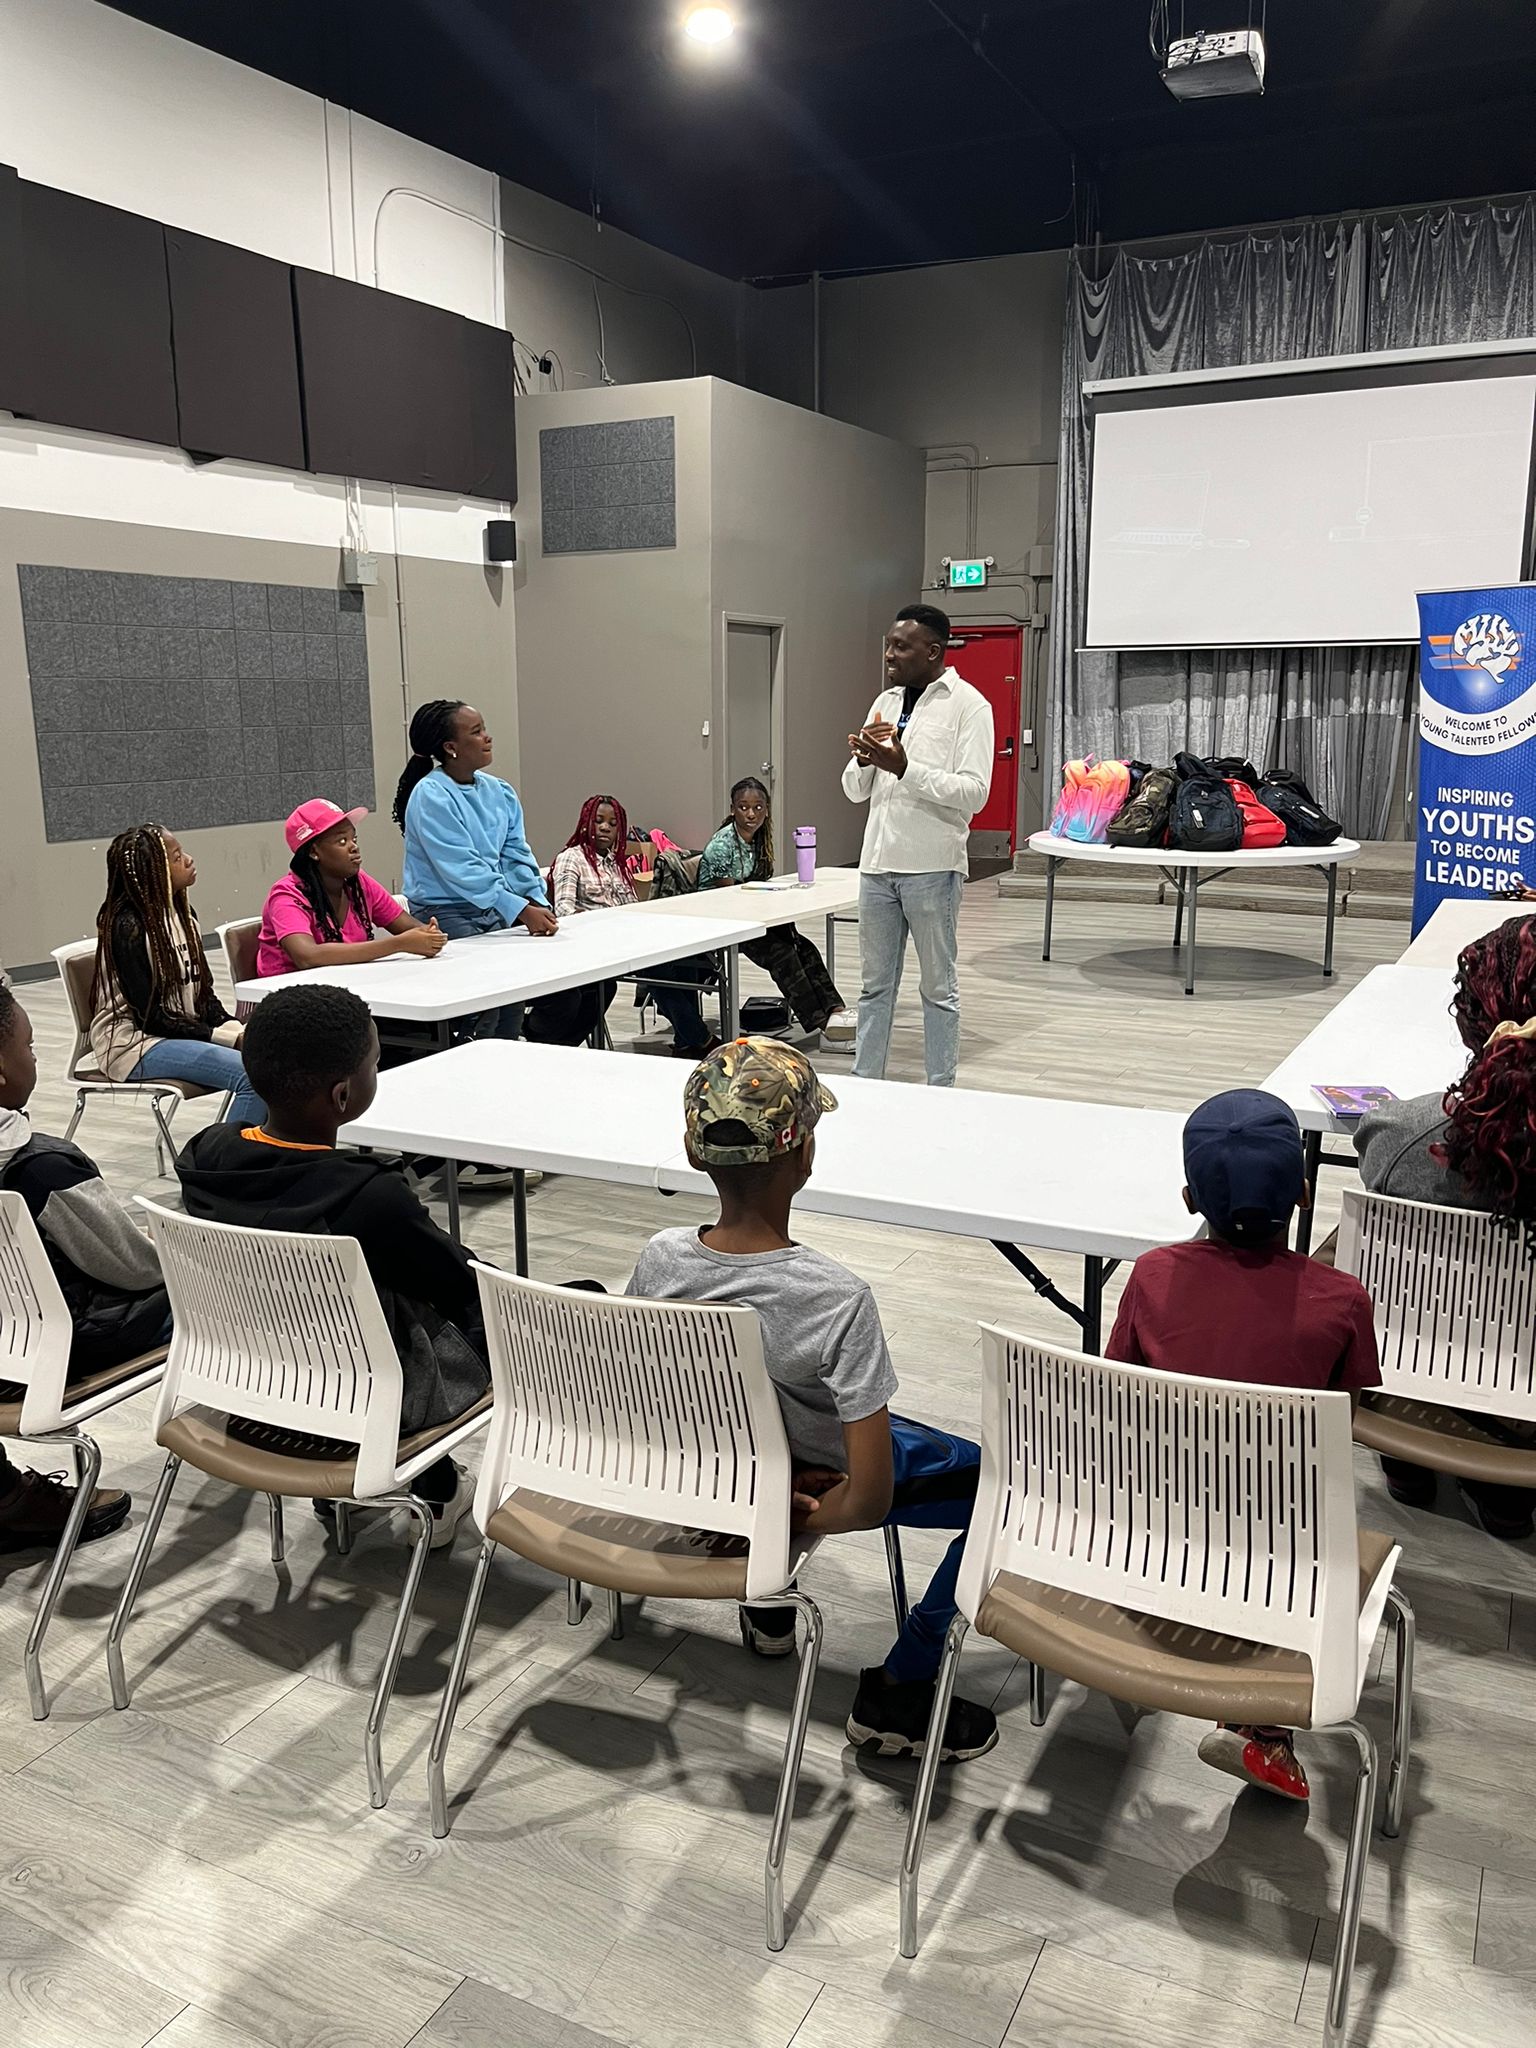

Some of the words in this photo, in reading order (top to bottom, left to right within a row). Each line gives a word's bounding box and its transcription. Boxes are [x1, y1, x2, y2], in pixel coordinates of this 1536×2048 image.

[1421, 714, 1449, 739] YOUNG
[1451, 733, 1496, 746] TALENTED
[1445, 716, 1491, 731] WELCOME
[1493, 715, 1508, 728] TO
[1437, 787, 1514, 808] INSPIRING
[1422, 807, 1535, 844] YOUTHS
[1430, 840, 1452, 856] TO
[1455, 842, 1520, 865] BECOME
[1425, 860, 1524, 892] LEADERS
